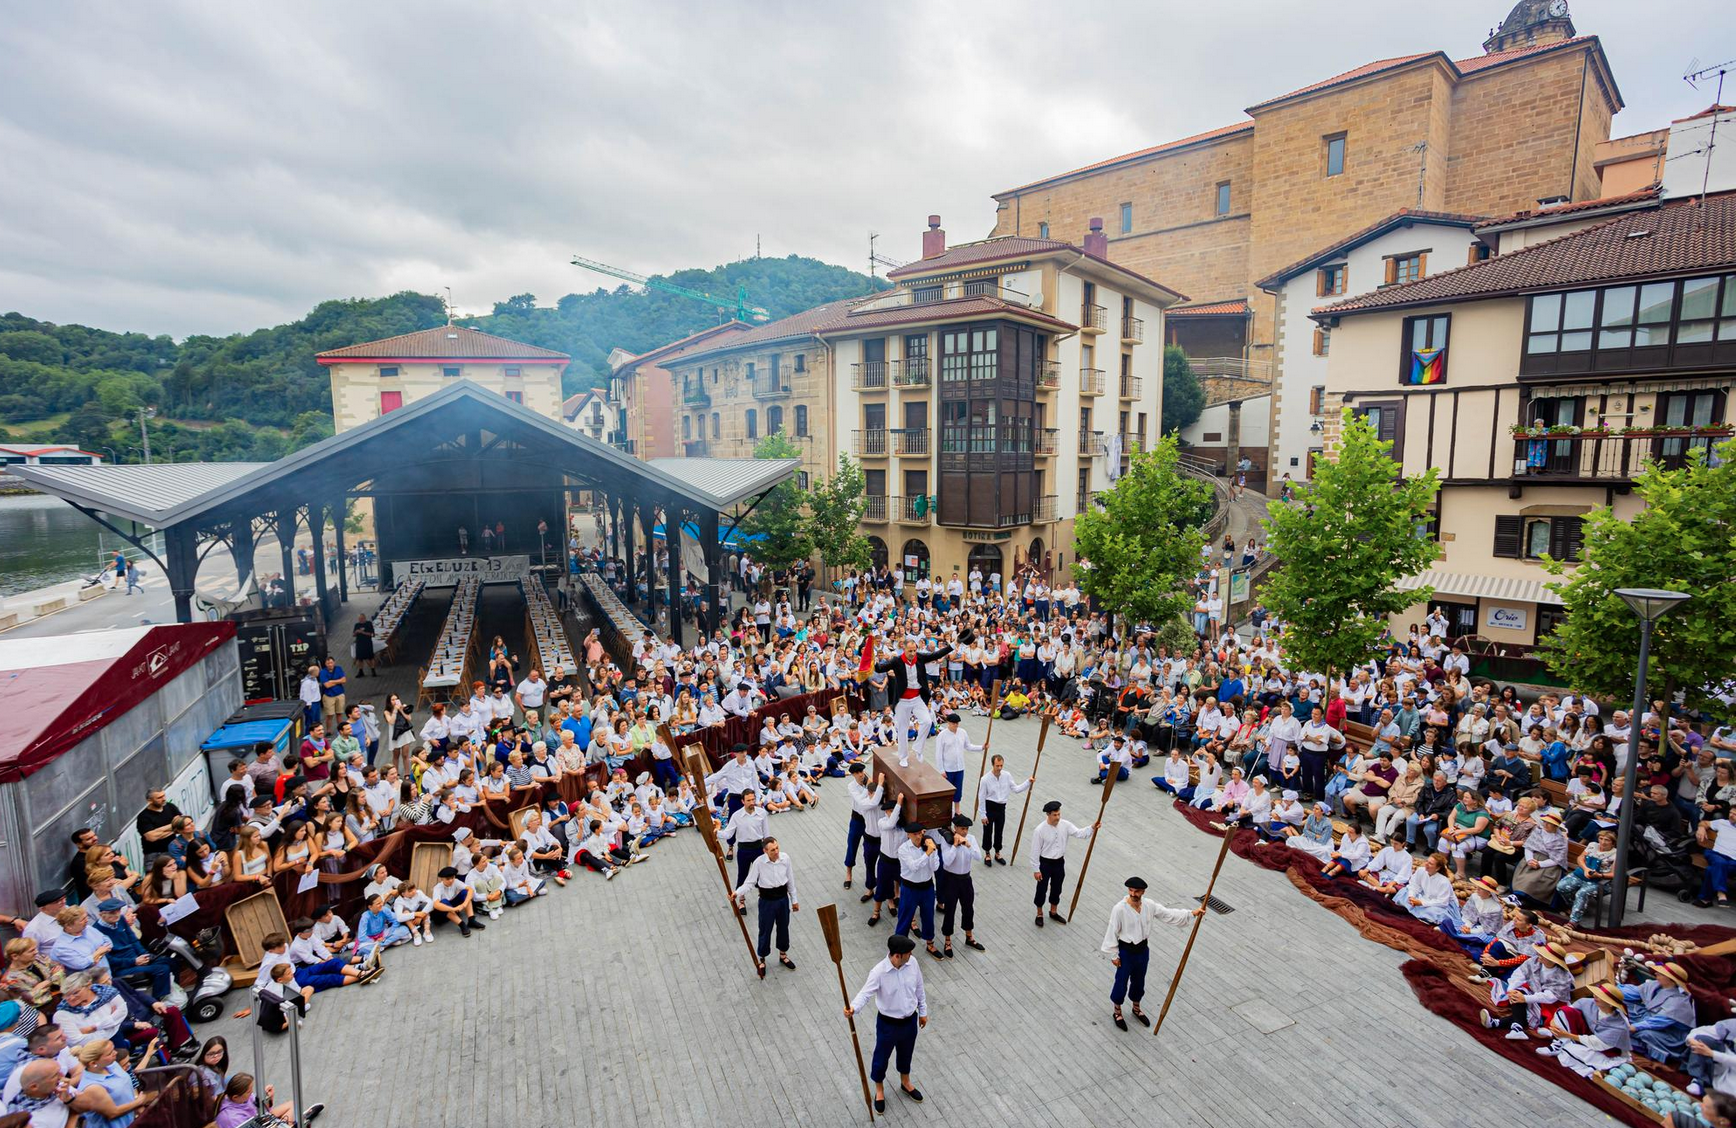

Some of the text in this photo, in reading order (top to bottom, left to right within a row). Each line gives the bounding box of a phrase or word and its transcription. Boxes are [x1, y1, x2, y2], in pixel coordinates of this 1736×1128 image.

[487, 559, 502, 571] 13
[1494, 609, 1518, 621] Orio
[290, 642, 310, 653] TXP
